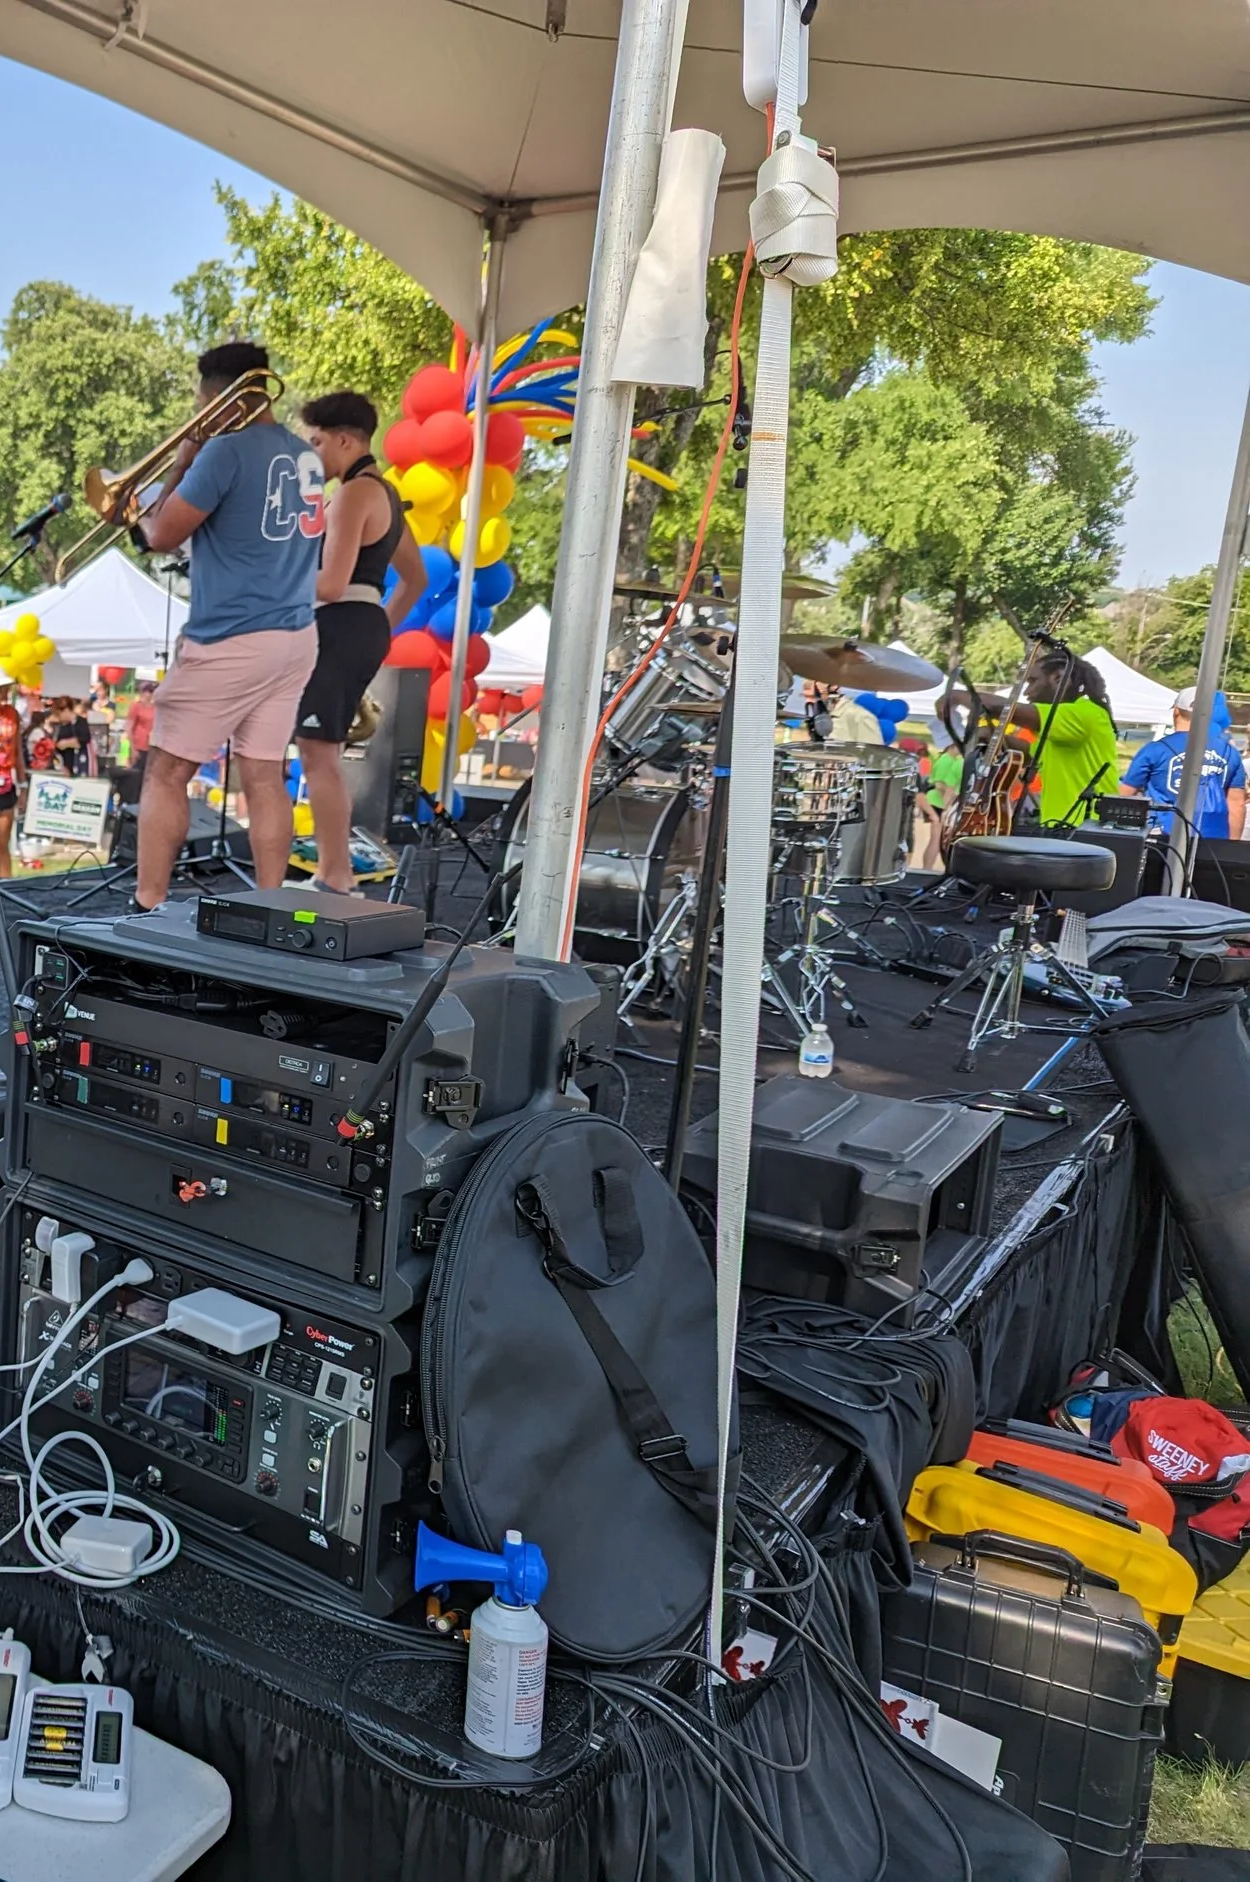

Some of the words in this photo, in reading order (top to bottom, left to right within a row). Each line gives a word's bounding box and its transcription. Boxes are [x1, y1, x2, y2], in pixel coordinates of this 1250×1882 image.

[261, 451, 325, 541] CS
[44, 800, 68, 812] DAY
[36, 820, 74, 830] MEMORIAL
[76, 824, 93, 832] DAY
[77, 1010, 96, 1021] VENUE
[306, 1325, 356, 1351] CyberPower
[1148, 1429, 1210, 1476] SWEENEY
[1148, 1454, 1188, 1481] staff
[993, 1774, 1004, 1797] Ap
